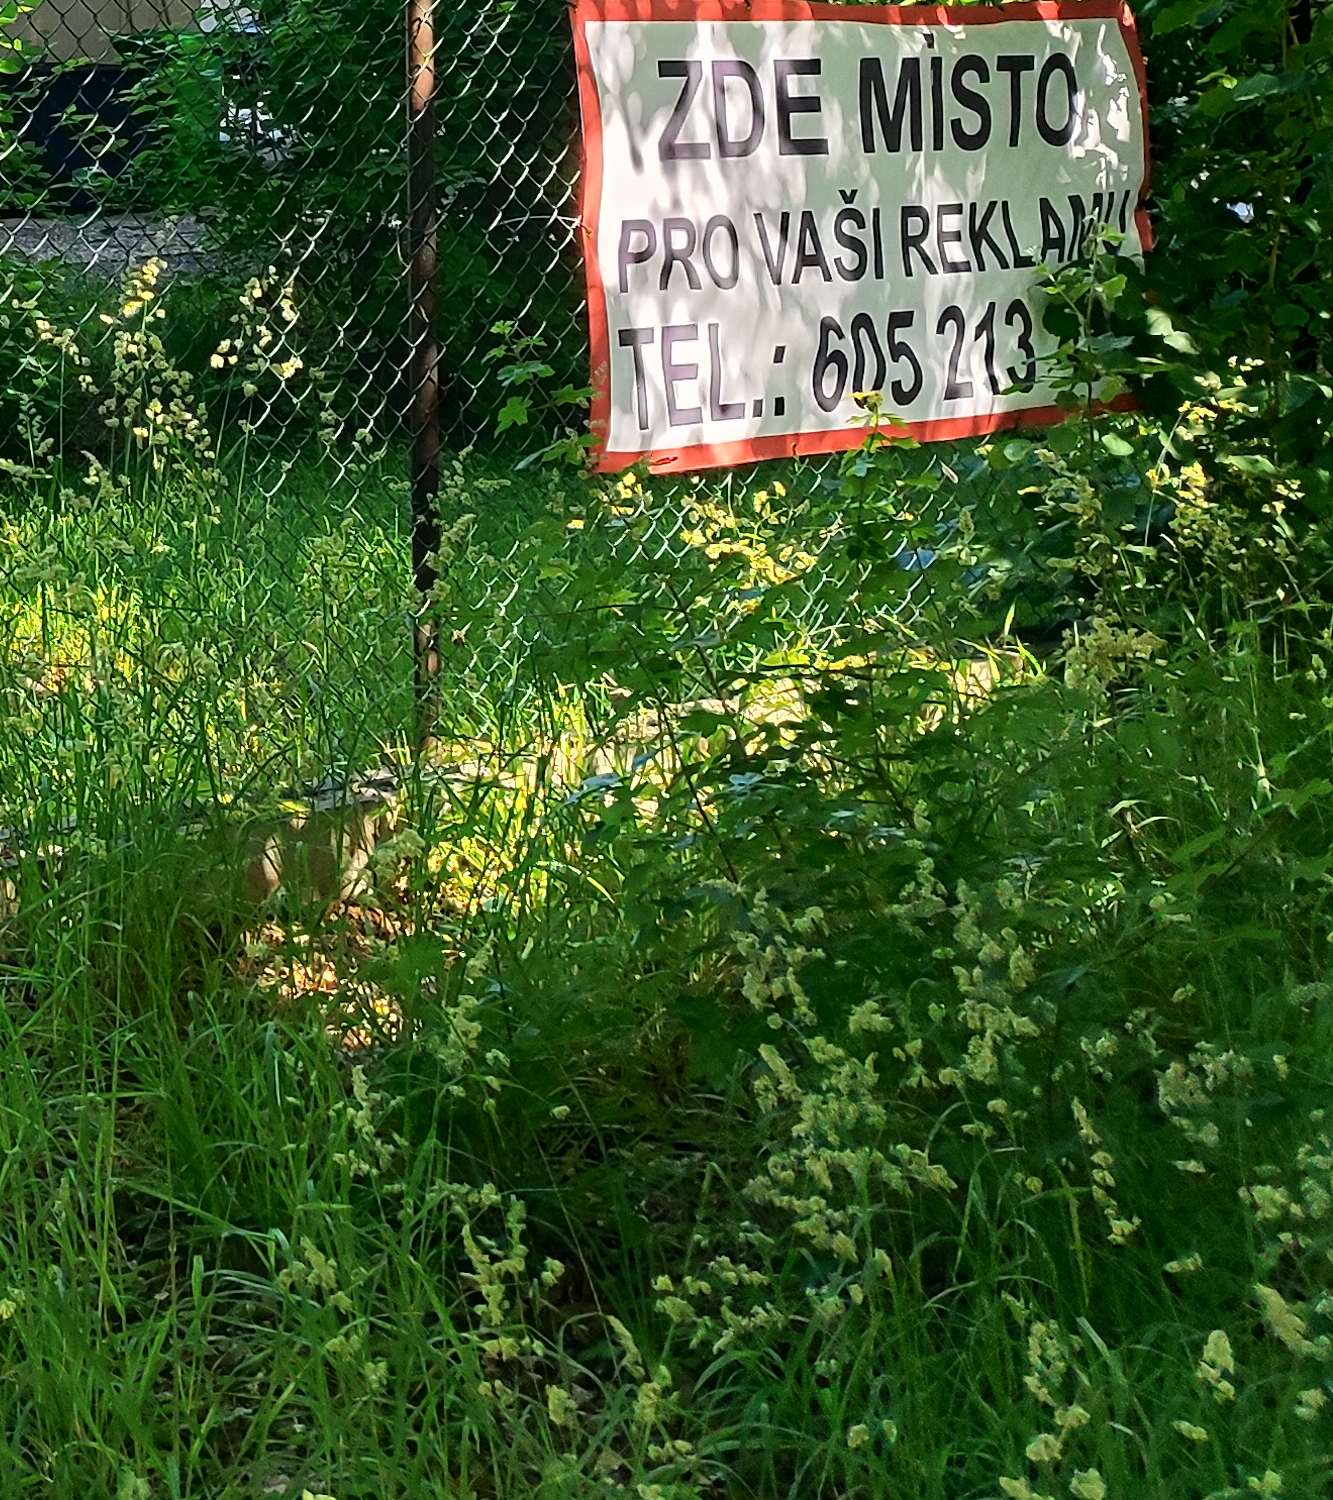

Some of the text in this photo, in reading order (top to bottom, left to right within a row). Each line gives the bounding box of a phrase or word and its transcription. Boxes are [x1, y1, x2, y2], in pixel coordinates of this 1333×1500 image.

[657, 33, 1078, 161] ZDE MÍSTO
[617, 215, 740, 294] PRO
[753, 189, 885, 286] VAŠI
[812, 311, 923, 414] 605
[935, 298, 1037, 402] 213
